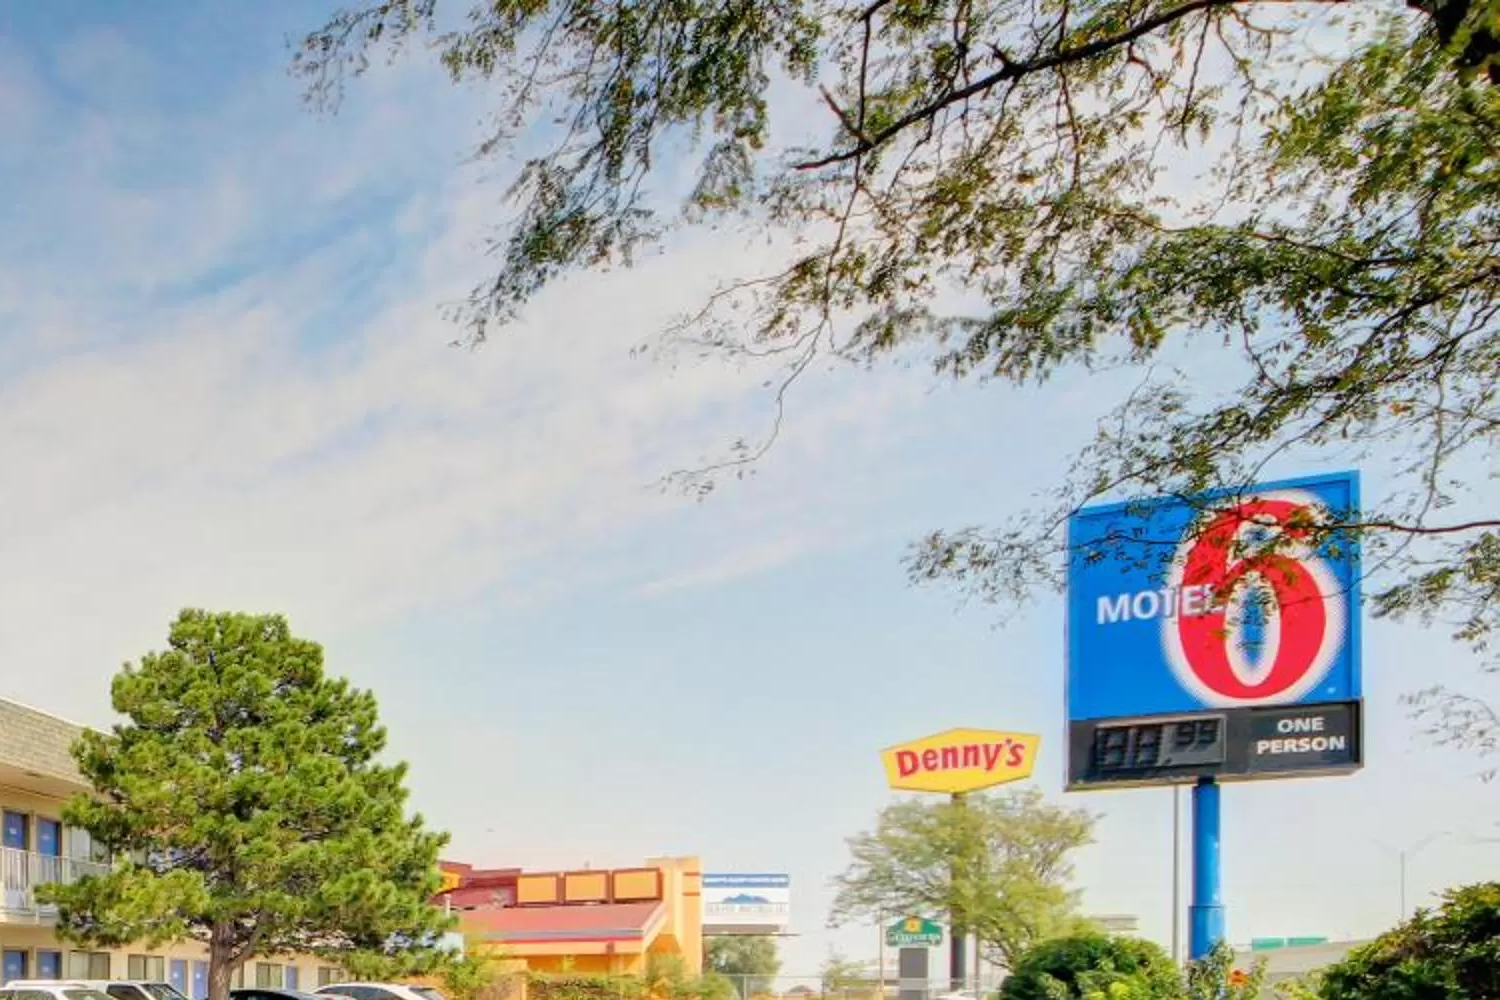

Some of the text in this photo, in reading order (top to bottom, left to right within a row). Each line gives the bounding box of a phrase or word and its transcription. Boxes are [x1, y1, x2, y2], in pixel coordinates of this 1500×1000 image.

[1176, 498, 1328, 701] 6
[1277, 716, 1325, 734] ONE
[894, 737, 1025, 778] Denny's
[1256, 735, 1346, 755] PERSON
